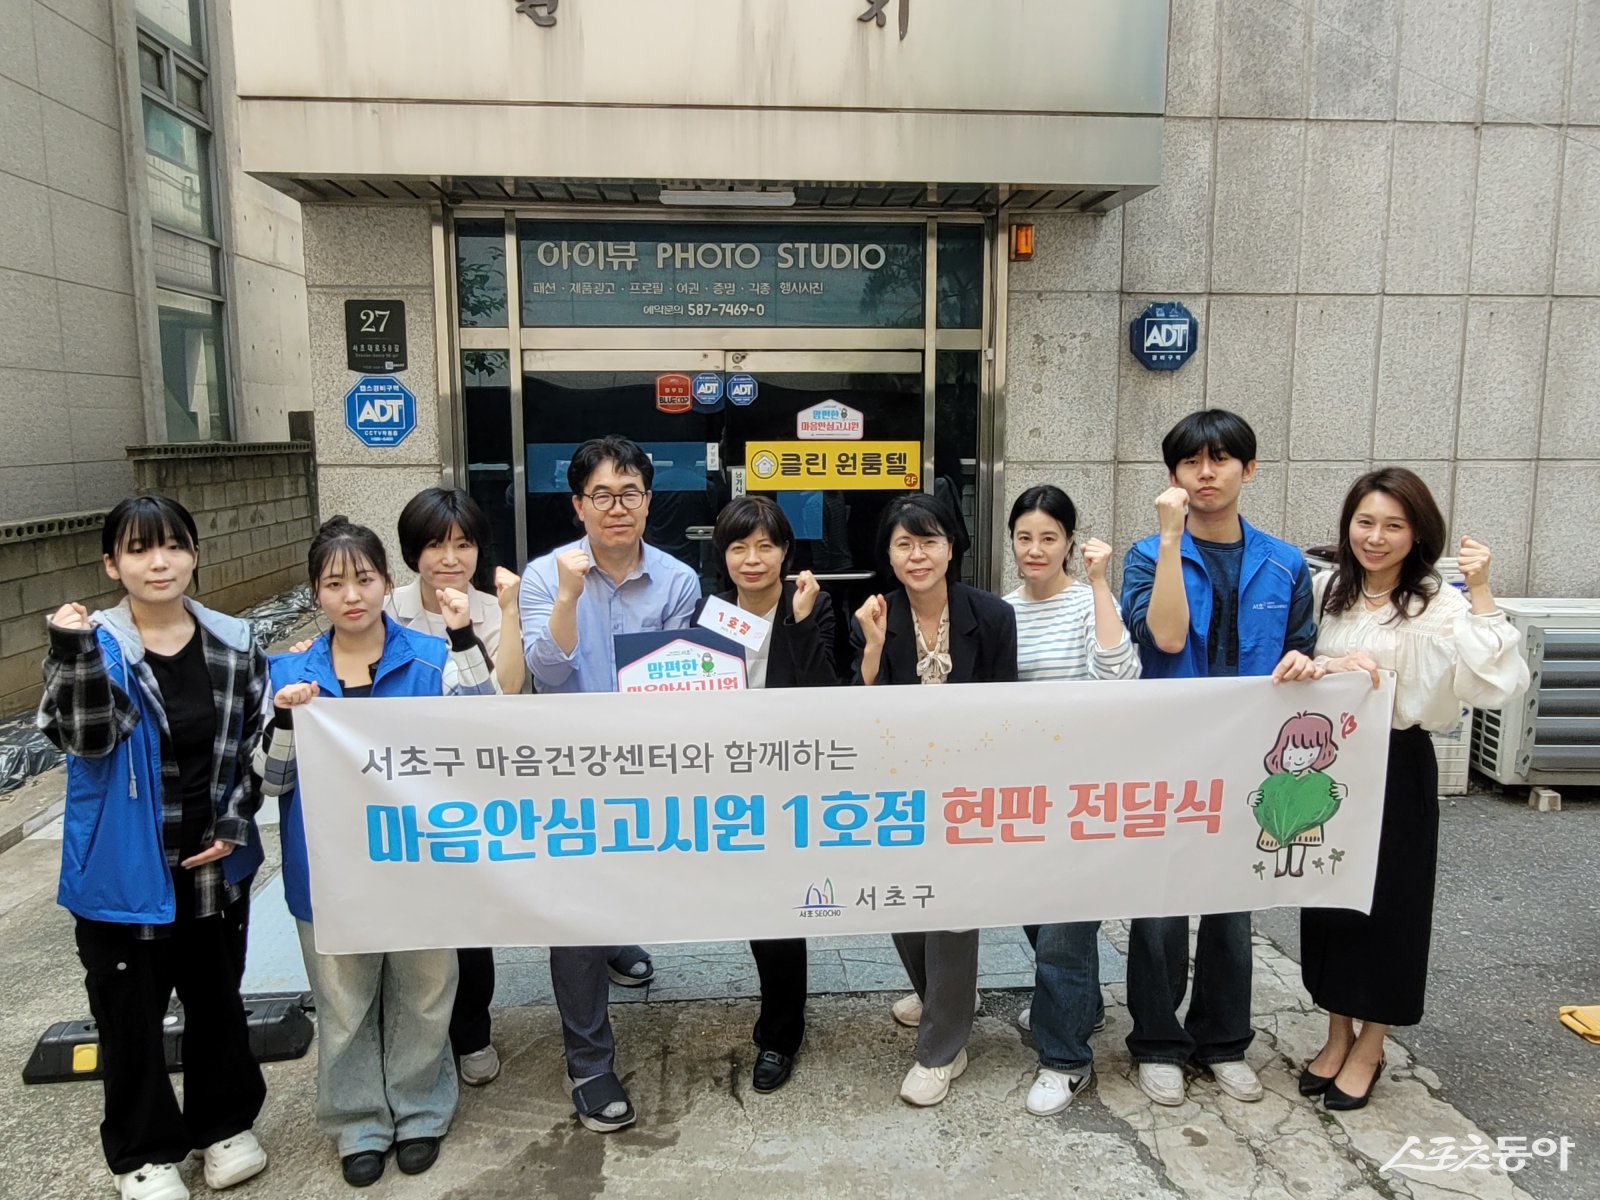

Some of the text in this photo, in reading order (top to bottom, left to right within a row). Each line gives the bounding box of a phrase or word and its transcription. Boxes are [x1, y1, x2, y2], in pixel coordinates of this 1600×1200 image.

[537, 241, 886, 271] 아이뷰 PHOTO STUDIO
[532, 281, 557, 295] 패션
[569, 281, 615, 295] 제품광고
[629, 281, 664, 295] 프로필
[676, 281, 700, 295] 여권
[712, 281, 736, 295] 증명
[779, 281, 824, 296] 행사사진
[360, 309, 391, 333] 27
[1145, 324, 1188, 347] ADT
[697, 382, 719, 394] ADT
[732, 384, 753, 396] ADT
[358, 399, 404, 423] ADT
[659, 396, 690, 404] BLUECOP
[801, 421, 859, 431] 마음안심고시원
[780, 452, 908, 477] 클린 원룸텔
[905, 475, 919, 487] 2F
[647, 658, 699, 680] 맘편한
[361, 738, 858, 781] 서초구 마음건강센터와 함께하는
[366, 778, 1224, 864] 마음안심고시원 1호점 현판 전달식
[855, 885, 936, 911] 서초구
[799, 909, 841, 918] 서초 SEOCHO
